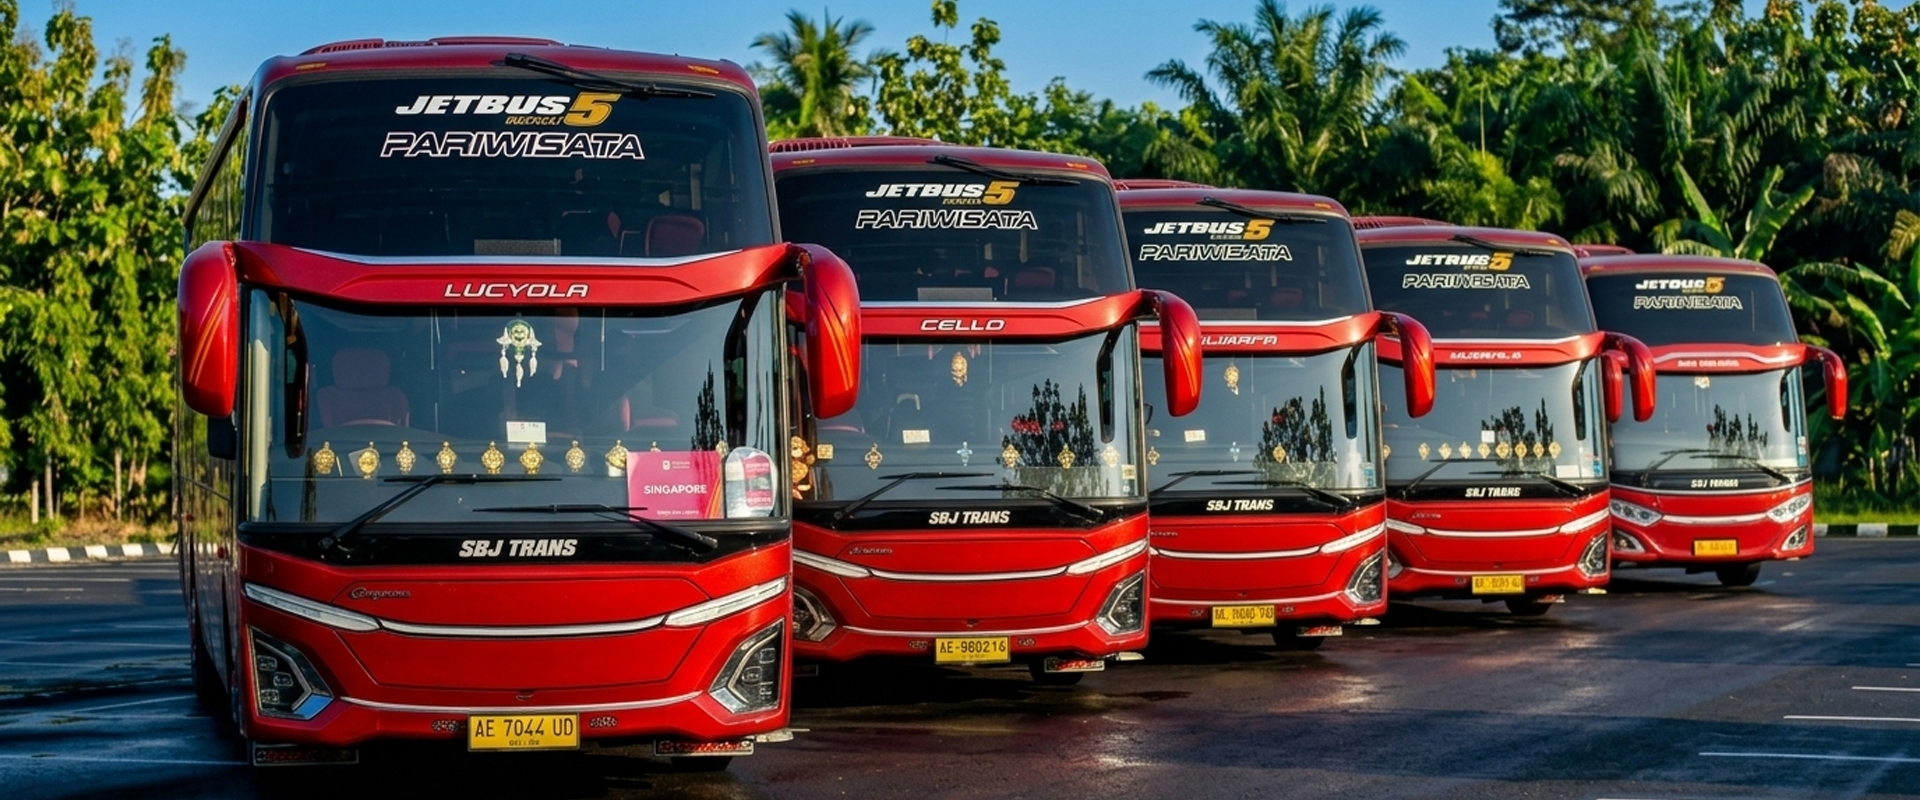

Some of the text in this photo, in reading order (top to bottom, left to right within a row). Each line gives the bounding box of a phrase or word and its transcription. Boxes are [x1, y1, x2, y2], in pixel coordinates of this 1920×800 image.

[395, 91, 621, 126] JETBUS 5
[381, 131, 645, 159] PARIWISATA
[866, 181, 1020, 205] JETBUS 5
[855, 210, 1038, 230] PARIWISATA
[1144, 222, 1245, 234] JETBUS
[444, 283, 589, 298] LUCYOLA
[920, 319, 1006, 331] CELLO
[644, 484, 707, 495] SINGAPORE
[1234, 499, 1274, 511] TRANS
[929, 510, 1010, 524] SBJ TRANS
[458, 539, 578, 557] SBJ TRANS
[475, 718, 573, 737] AE 7044 UD
